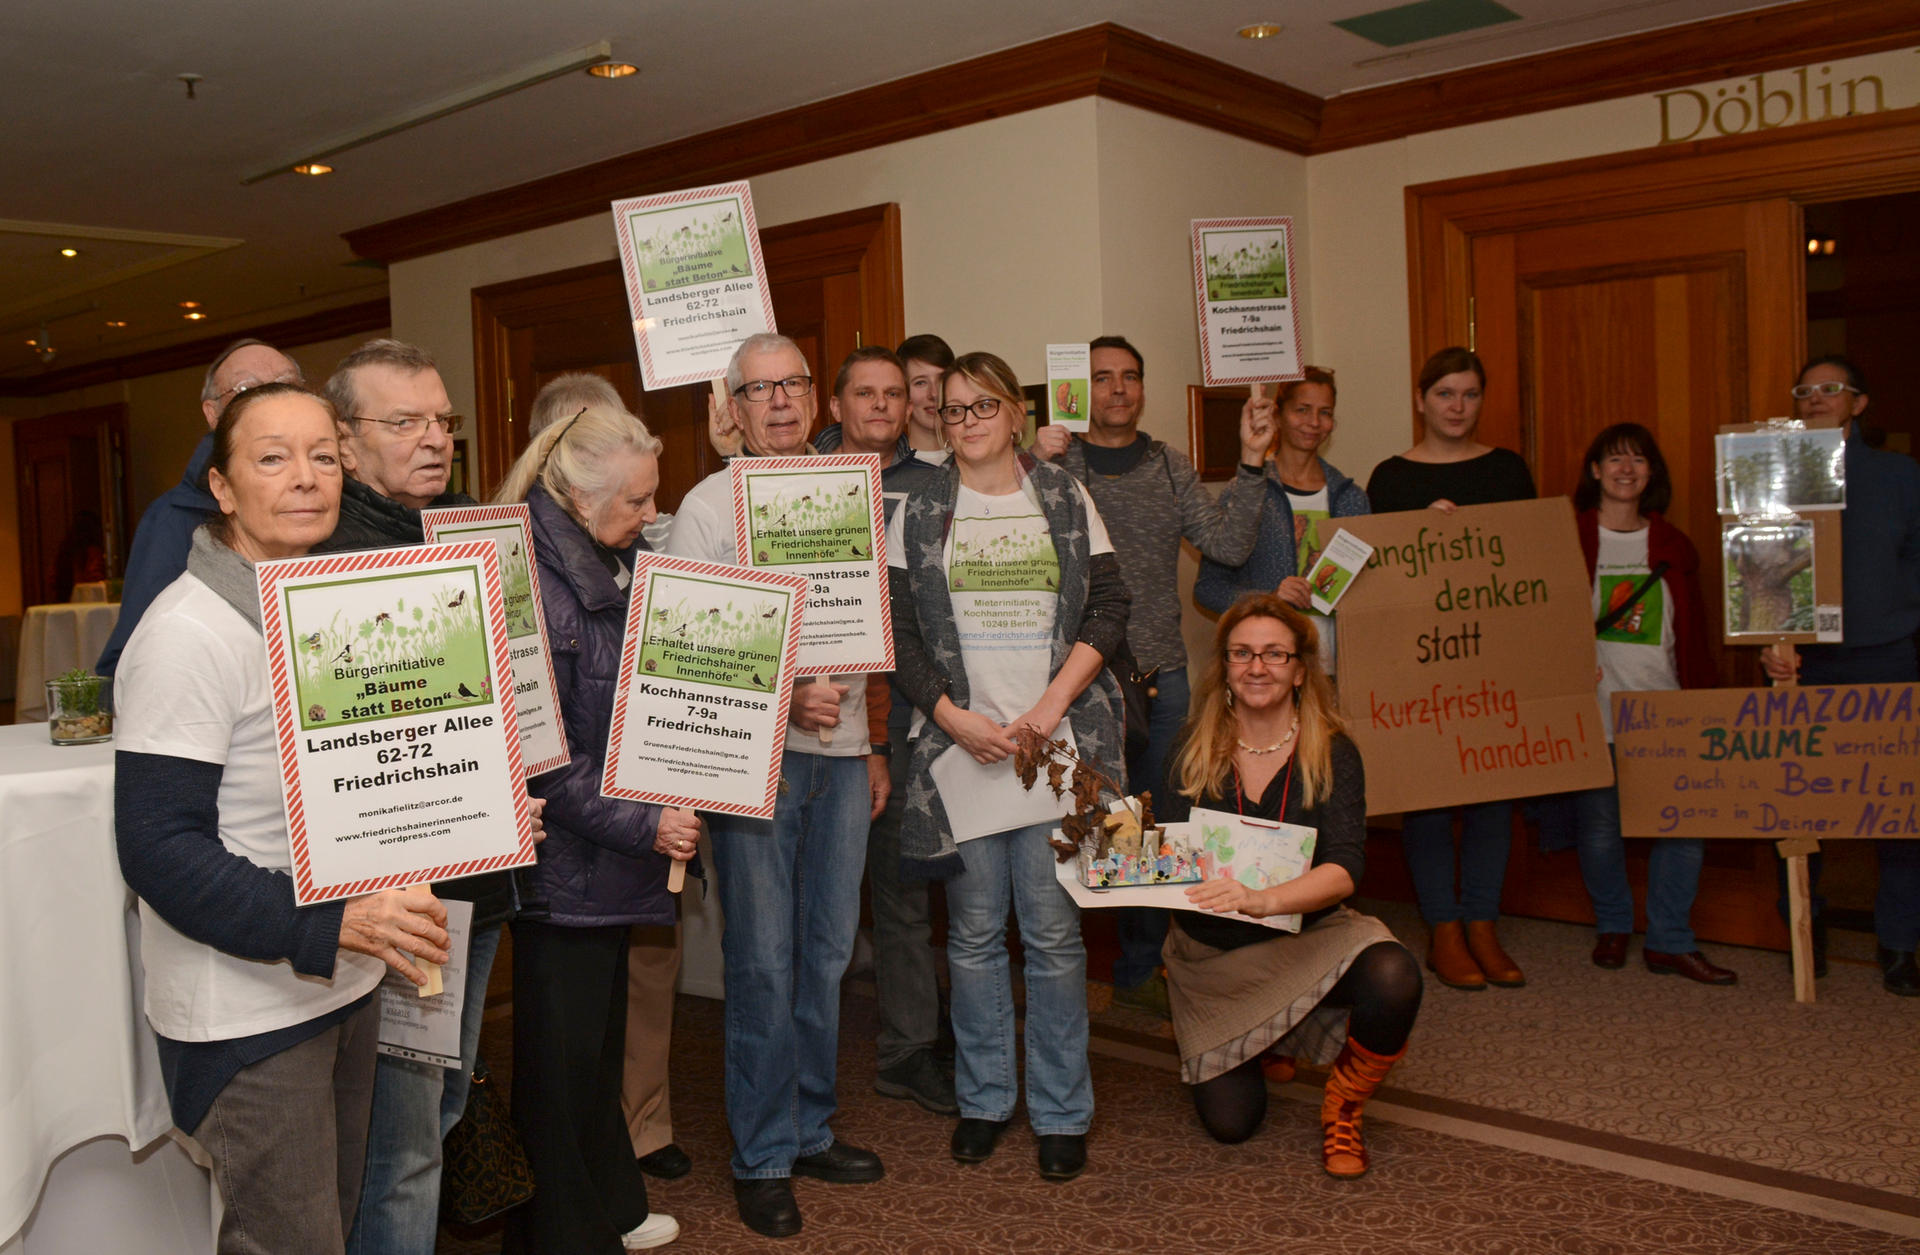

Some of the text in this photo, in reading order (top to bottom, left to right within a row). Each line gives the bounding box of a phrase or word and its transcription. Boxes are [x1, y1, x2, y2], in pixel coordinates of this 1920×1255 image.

[1652, 65, 1892, 147] Döblin
[659, 249, 723, 266] Bürgerinitiative
[665, 270, 728, 288] statt Beton“
[647, 281, 754, 306] Landsberger Allee
[686, 298, 719, 311] 62-72
[663, 307, 747, 327] Friedrichshain
[1212, 303, 1287, 314] Kochhannstrasse
[1241, 314, 1261, 323] 7-9a
[1221, 325, 1282, 335] Friedrichshain
[752, 526, 869, 541] „Erhaltet unsere grünen
[771, 538, 852, 550] Friedrichshainer
[786, 549, 839, 561] Innenhöfe“
[995, 559, 1028, 568] unsere
[1364, 526, 1506, 578] angfristig
[801, 569, 870, 581] nnstrasse
[967, 568, 1048, 577] Friedrichshainer
[808, 583, 830, 595] -9a
[1435, 574, 1548, 612] denken
[963, 610, 1022, 618] Kochhannstr.
[974, 599, 1041, 607] Mieterinitiative
[981, 620, 1038, 629] 10249 Berlin
[643, 635, 778, 663] „Erhaltet unsere grünen
[1416, 621, 1482, 664] statt
[334, 654, 446, 681] Bürgerinitiative
[662, 650, 755, 673] Friedrichshainer
[676, 665, 739, 683] Innenhöfe“
[356, 677, 428, 701] „Bäume
[640, 683, 768, 711] Kochhannstrasse
[341, 691, 452, 721] statt Beton“
[687, 705, 718, 721] 7-9a
[1370, 680, 1519, 735] kurzfristig
[1665, 715, 1693, 728] nur
[1735, 687, 1920, 727] AMAZONA
[307, 721, 438, 754] Landsberger
[443, 714, 494, 733] Allee
[647, 716, 752, 741] Friedrichshain
[376, 742, 433, 765] 62-72
[1457, 712, 1590, 775] handeln!
[1624, 739, 1687, 759] werden
[1700, 725, 1827, 761] BÄUME
[333, 758, 479, 794] Friedrichshain
[667, 765, 719, 779] wordpress.com
[1739, 775, 1760, 790] in
[1774, 762, 1914, 797] Berlin
[358, 795, 464, 819] monikafielitz@arcor.de
[1658, 805, 1718, 832] ganz
[1734, 803, 1749, 820] in
[1753, 803, 1840, 832] Deiner
[335, 811, 490, 843] www.friedrichshainerinnenhoefe.
[379, 826, 451, 846] wordpress.com
